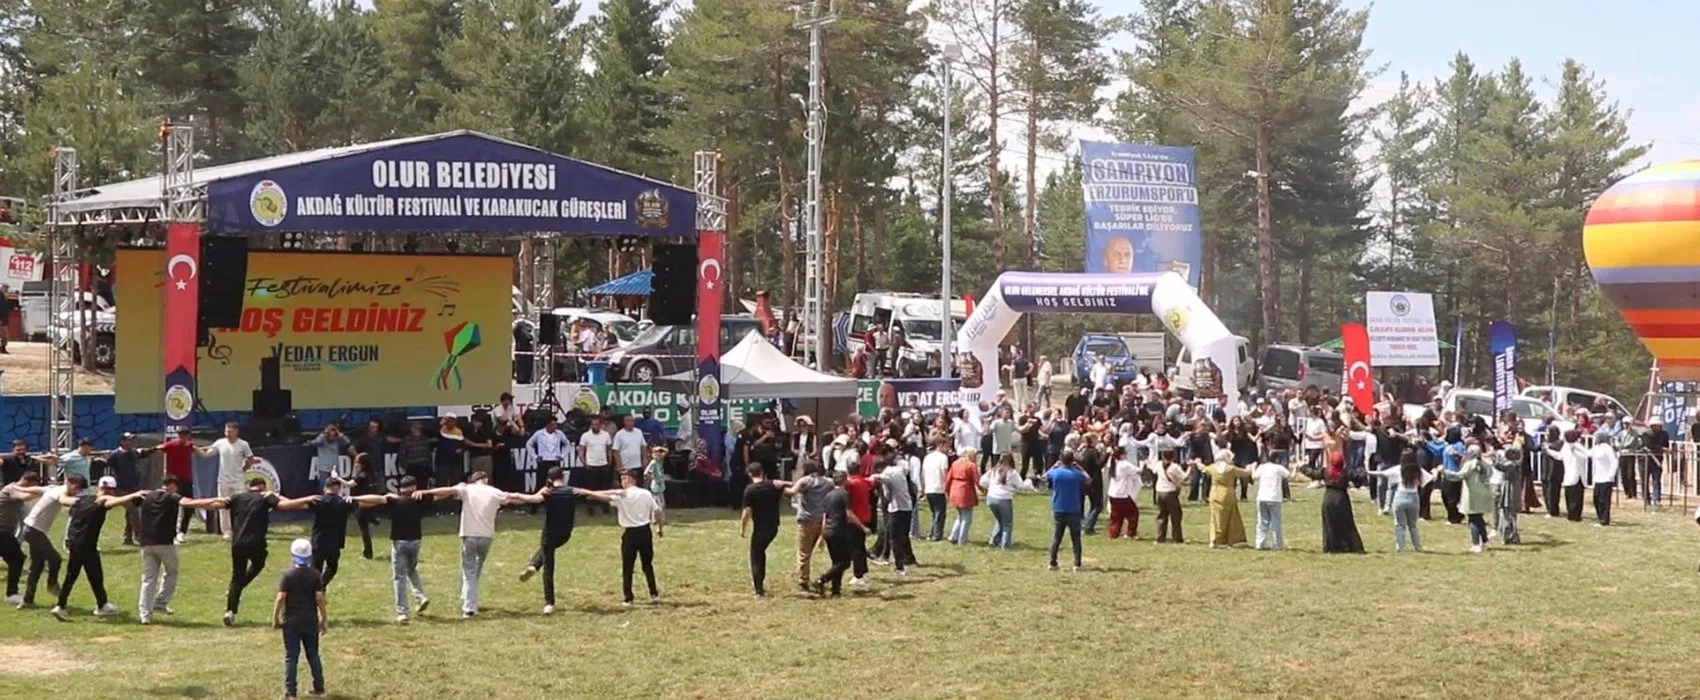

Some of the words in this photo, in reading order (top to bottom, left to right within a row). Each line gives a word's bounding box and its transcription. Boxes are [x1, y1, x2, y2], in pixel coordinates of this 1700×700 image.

[372, 160, 430, 188] OLUR
[437, 161, 556, 190] BELEDİYESİ
[297, 194, 342, 216] AKDAĞ
[346, 194, 394, 216] KÜLTÜR
[398, 195, 461, 217] FESTİVALİ
[464, 198, 481, 216] VE
[482, 198, 558, 218] KARAKUCAK
[561, 197, 627, 222] GÜREŞLERİ
[15, 259, 33, 270] 112
[247, 275, 402, 298] Festivalimize
[219, 308, 284, 338] OŞ
[292, 302, 426, 333] GELDİNİZ
[270, 341, 324, 362] VEDAT
